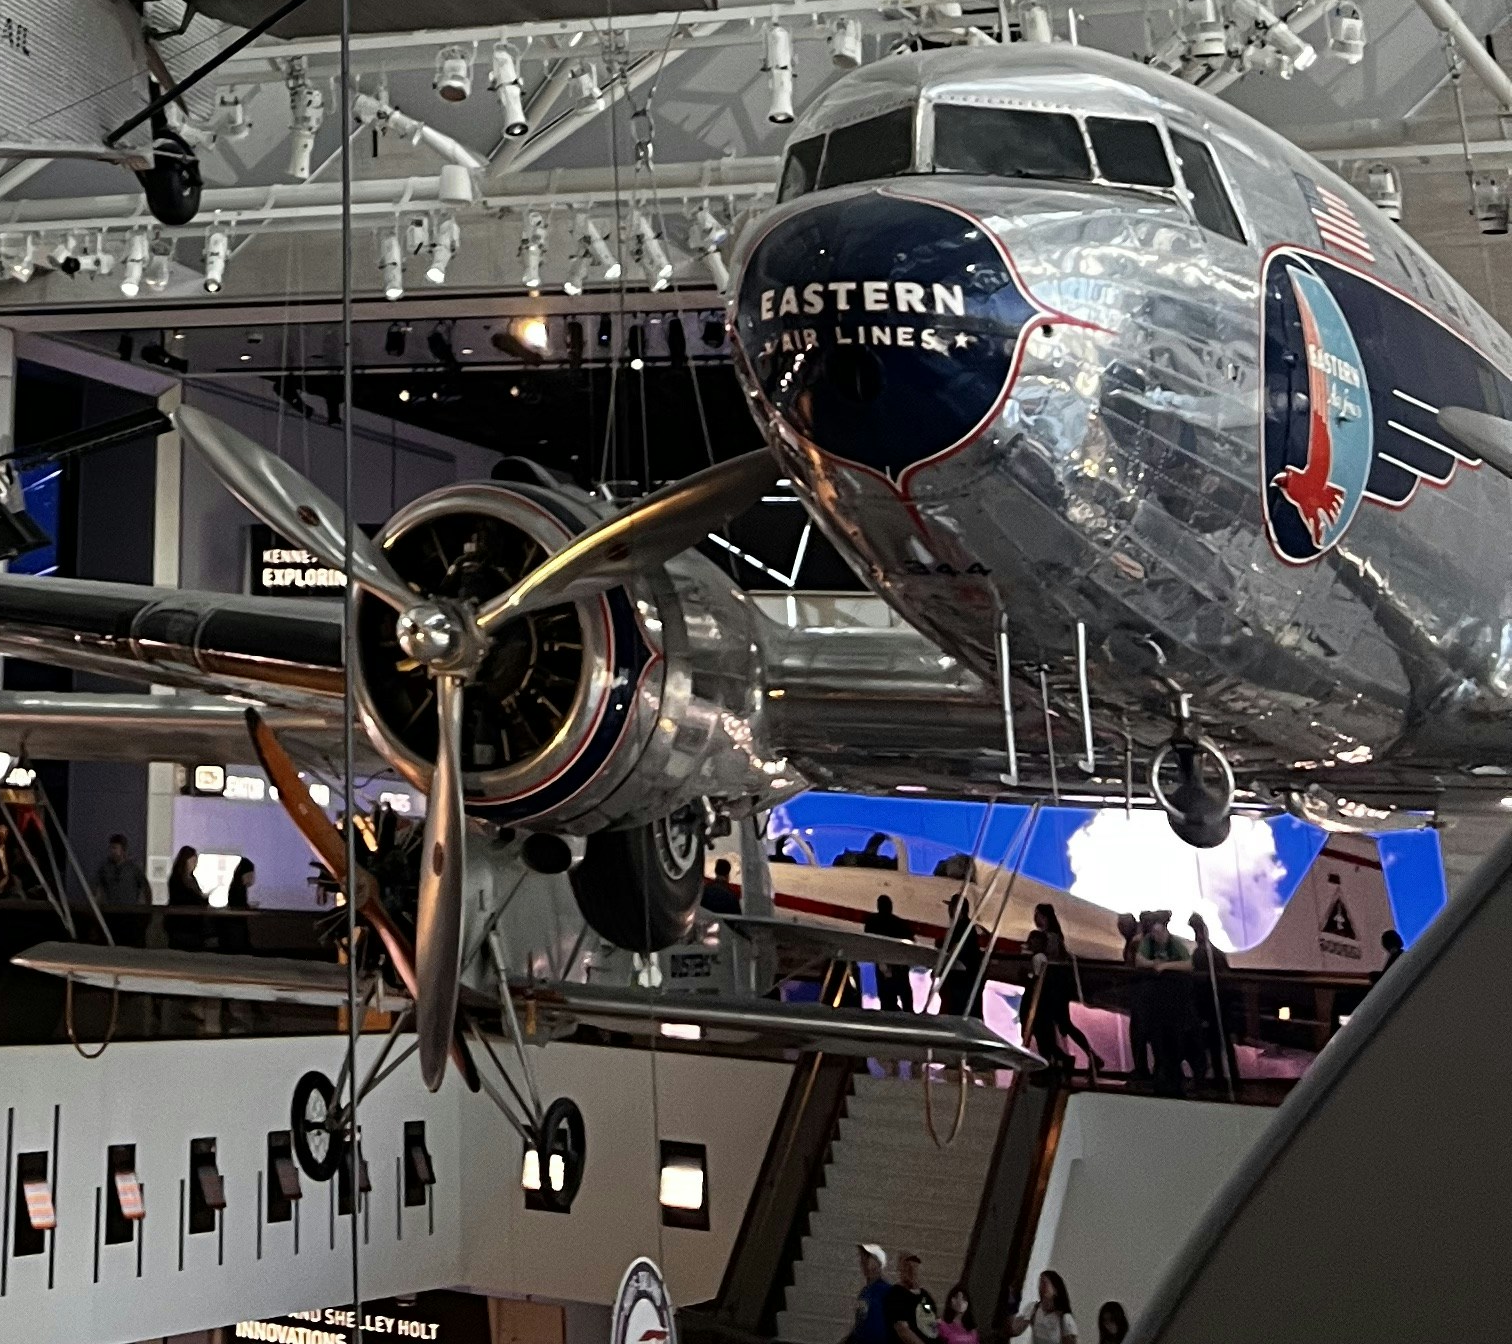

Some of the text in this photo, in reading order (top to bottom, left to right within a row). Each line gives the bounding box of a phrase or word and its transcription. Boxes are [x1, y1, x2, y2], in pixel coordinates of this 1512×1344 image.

[760, 281, 965, 321] EASTERN
[782, 326, 937, 353] AIR LINES
[1308, 343, 1360, 389] EASTERN
[262, 549, 319, 564] KENNE
[262, 568, 348, 587] EXPLORIN
[235, 1320, 348, 1344] INNOVATIONS
[324, 1308, 396, 1334] SHELEY
[397, 1319, 440, 1340] HOLT
